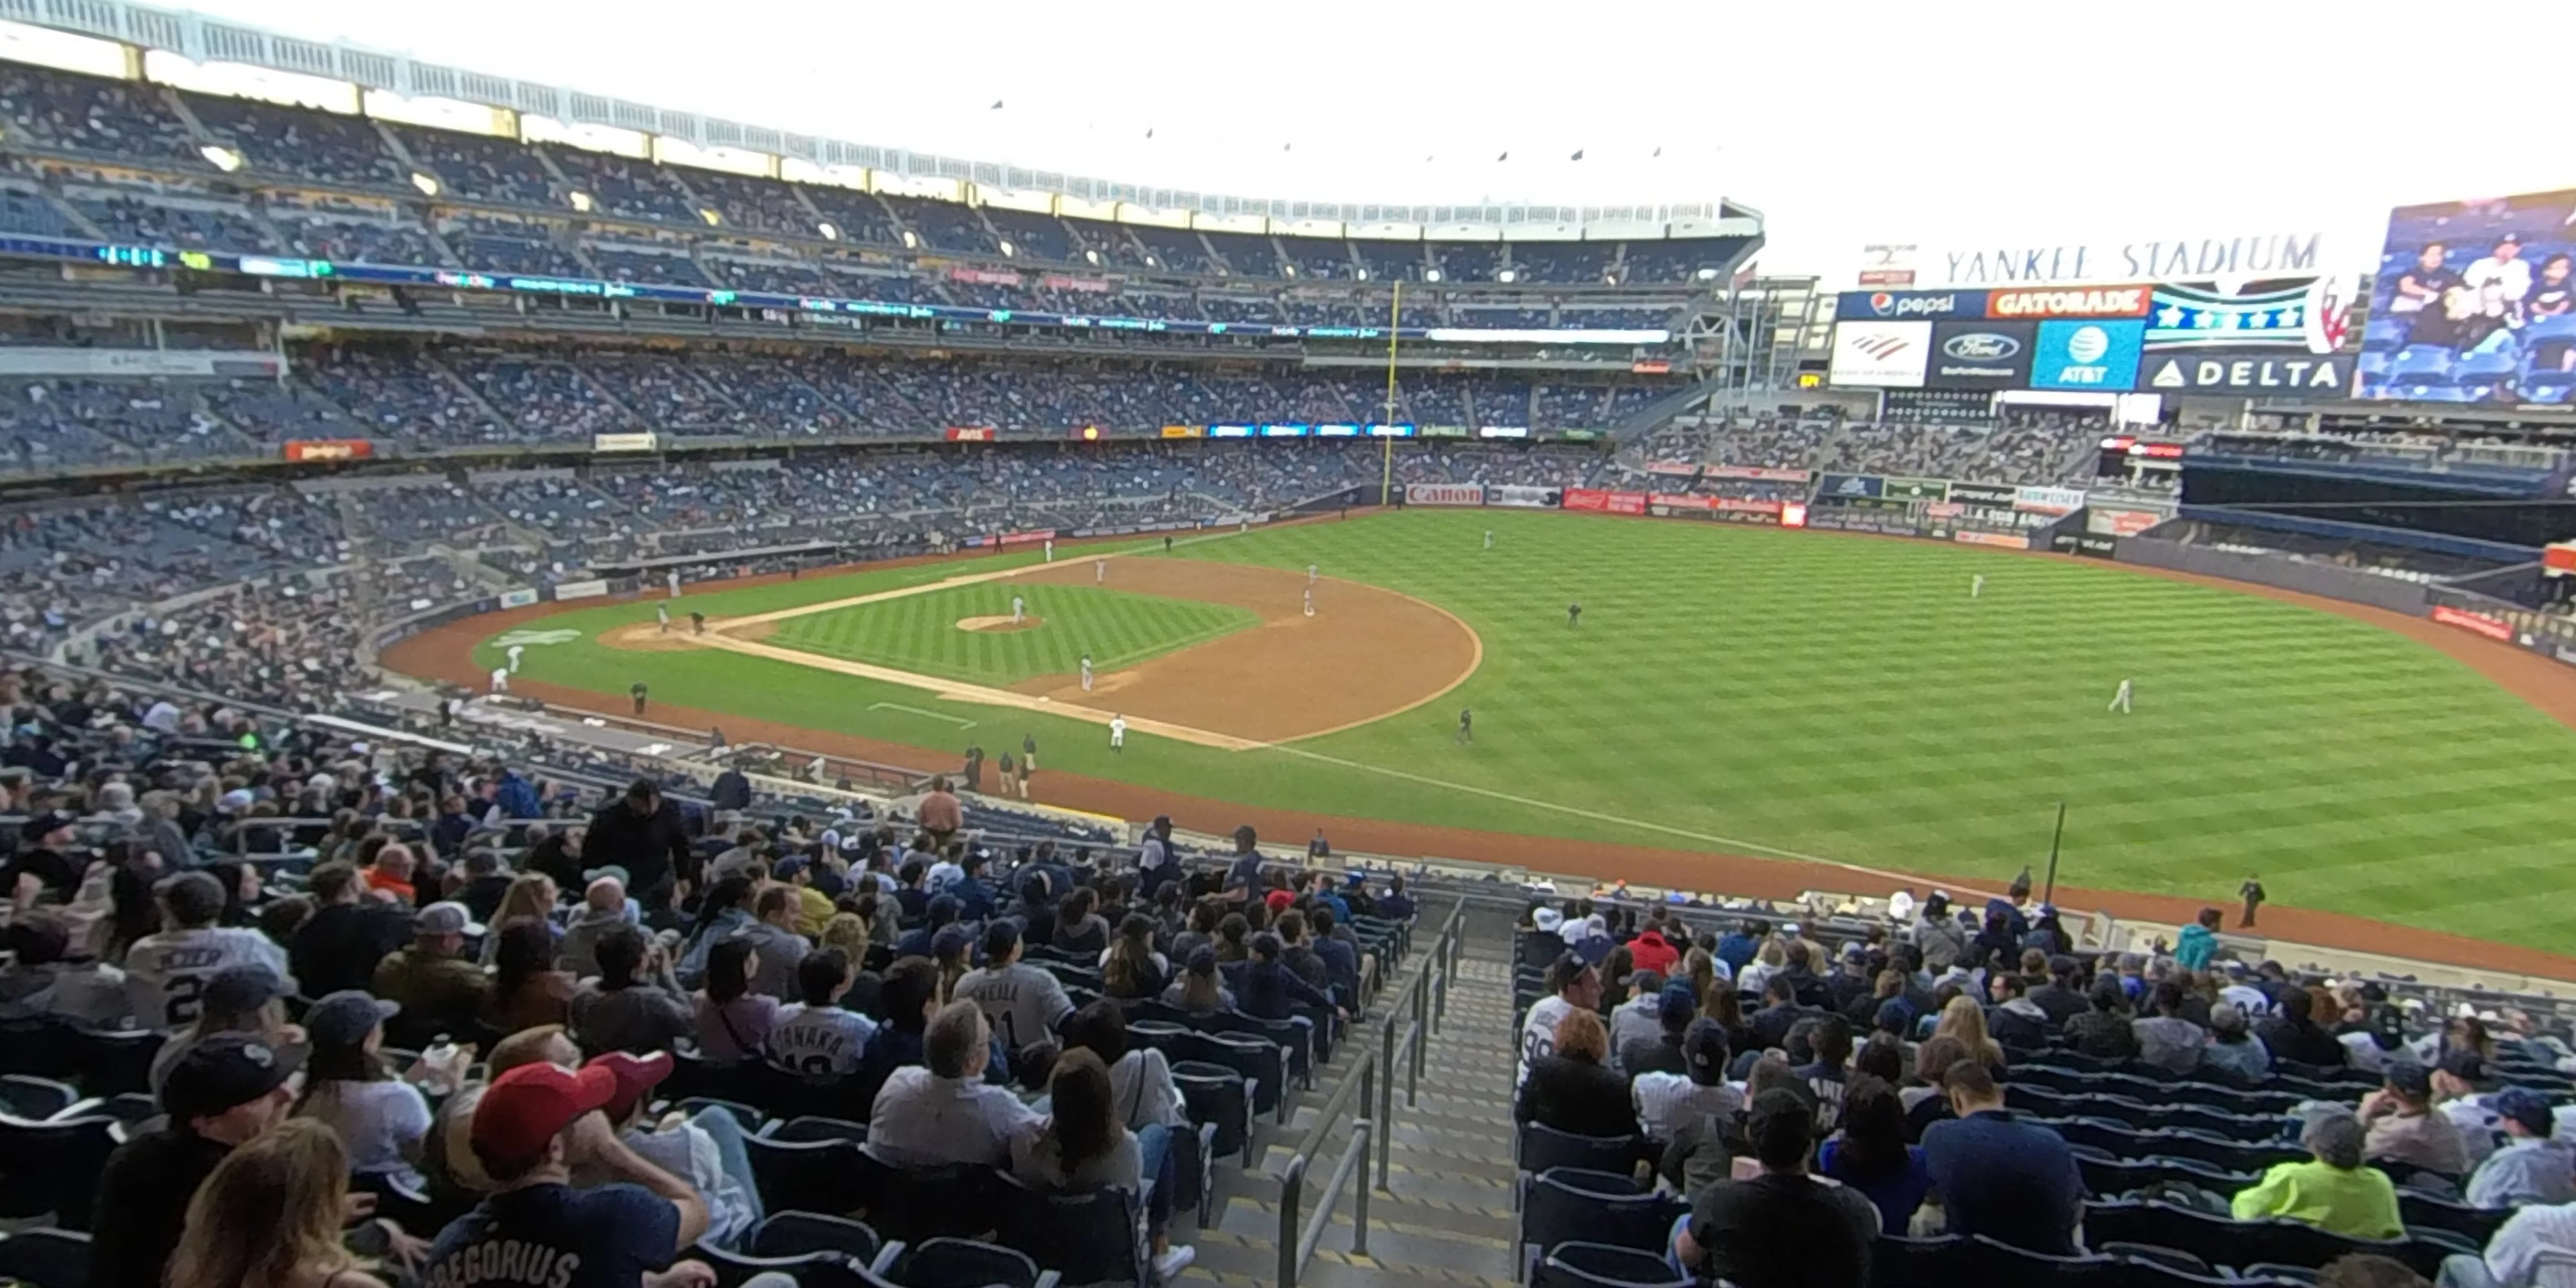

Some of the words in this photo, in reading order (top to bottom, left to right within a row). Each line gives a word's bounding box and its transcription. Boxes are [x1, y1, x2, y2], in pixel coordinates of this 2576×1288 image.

[1947, 246, 2092, 283] YANKEE
[2122, 232, 2321, 279] STADIUM
[1896, 294, 1954, 316] pepsi
[1996, 289, 2142, 315] GATORADE
[1956, 336, 2005, 356] Ford
[2058, 365, 2108, 383] AT&T
[2197, 361, 2338, 388] DELTA
[1409, 486, 1481, 502] Canon
[163, 973, 203, 1025] 2
